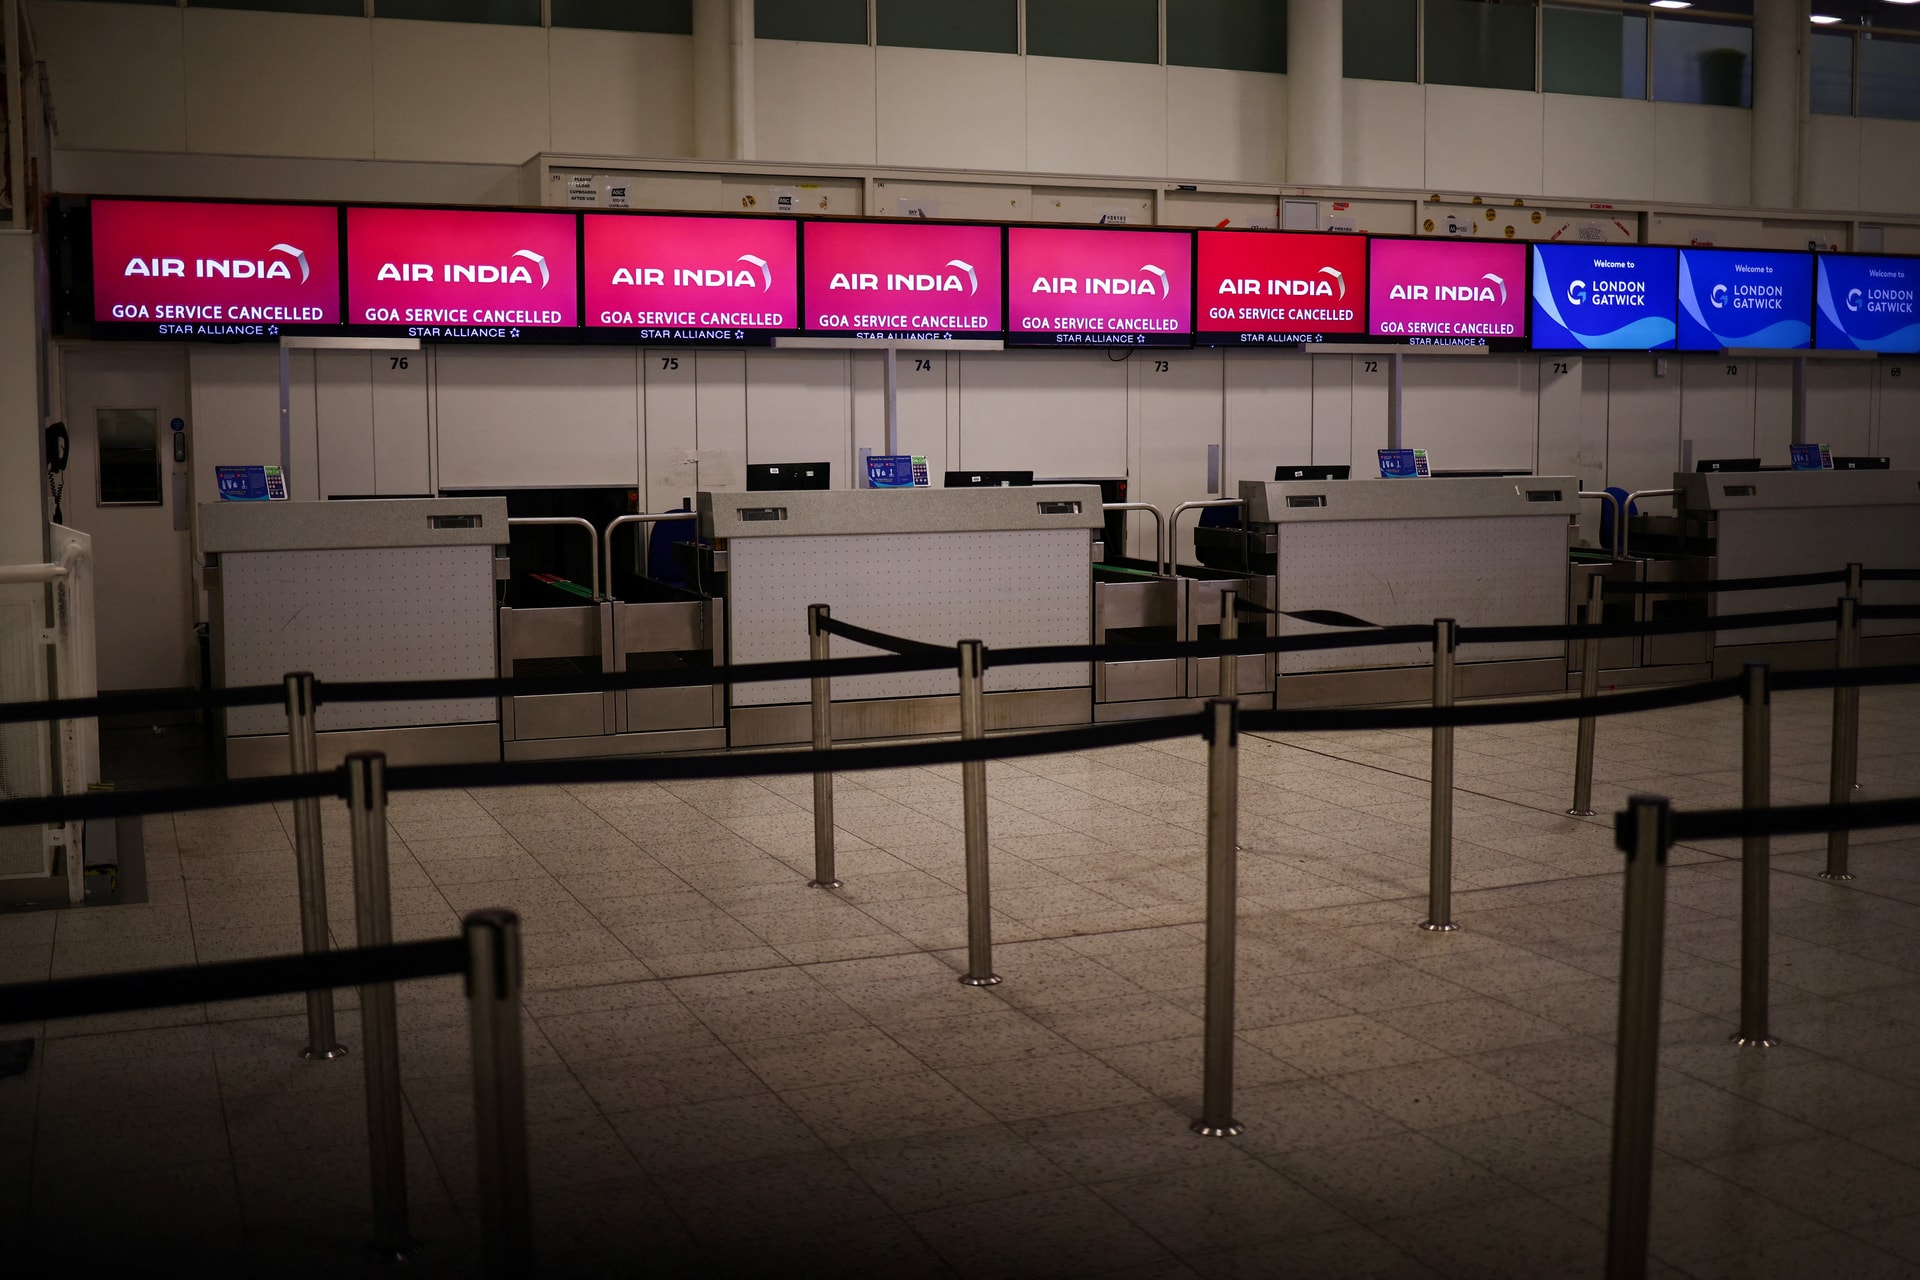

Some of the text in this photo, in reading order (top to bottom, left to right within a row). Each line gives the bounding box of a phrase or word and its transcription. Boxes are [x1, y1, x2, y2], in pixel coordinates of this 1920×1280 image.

[124, 258, 291, 279] AIR INDIA
[1594, 259, 1625, 268] Welcome
[377, 263, 532, 283] AIR INDIA
[612, 268, 755, 287] AIR INDIA
[1869, 269, 1896, 277] Welcome
[830, 273, 963, 291] AIR INDIA
[1032, 277, 1155, 295] AIR INDIA
[1219, 279, 1332, 296] AIR INDIA
[1592, 281, 1645, 292] LONDON
[1390, 285, 1495, 302] AIR INDIA
[1734, 285, 1783, 296] LONDON
[1868, 289, 1913, 300] LONDON
[1592, 294, 1644, 305] GATWICK
[1734, 298, 1782, 309] GATWICK
[112, 305, 323, 320] GOA SERVICE CANCELLED
[1867, 302, 1912, 312] GATWICK
[365, 308, 562, 323] GOA SERVICE CANCELLED
[601, 311, 783, 325] GOA SERVICE CANCELLED
[1210, 308, 1353, 320] GOA SERVICE CANCELLED
[819, 315, 988, 328] GOA SERVICE CANCELLED
[1022, 317, 1178, 330] GOA SERVICE CANCELLED
[159, 325, 263, 335] STAR ALLIANCE
[408, 328, 505, 338] STAR ALLIANCE
[1381, 322, 1514, 334] GOA SERVICE CANCELLED
[641, 330, 731, 339] STAR ALLIANCE
[887, 332, 939, 340] ALLIANCE
[1085, 335, 1133, 343] ALLIANCE
[1241, 334, 1312, 342] STAR ALLIANCE
[390, 357, 408, 369] 76
[662, 358, 678, 370] 75
[915, 360, 931, 371] 74
[1155, 361, 1168, 372] 73
[1365, 362, 1377, 372] 72
[1554, 364, 1568, 373] 71
[1727, 366, 1737, 375] 70
[1891, 368, 1900, 376] 69
